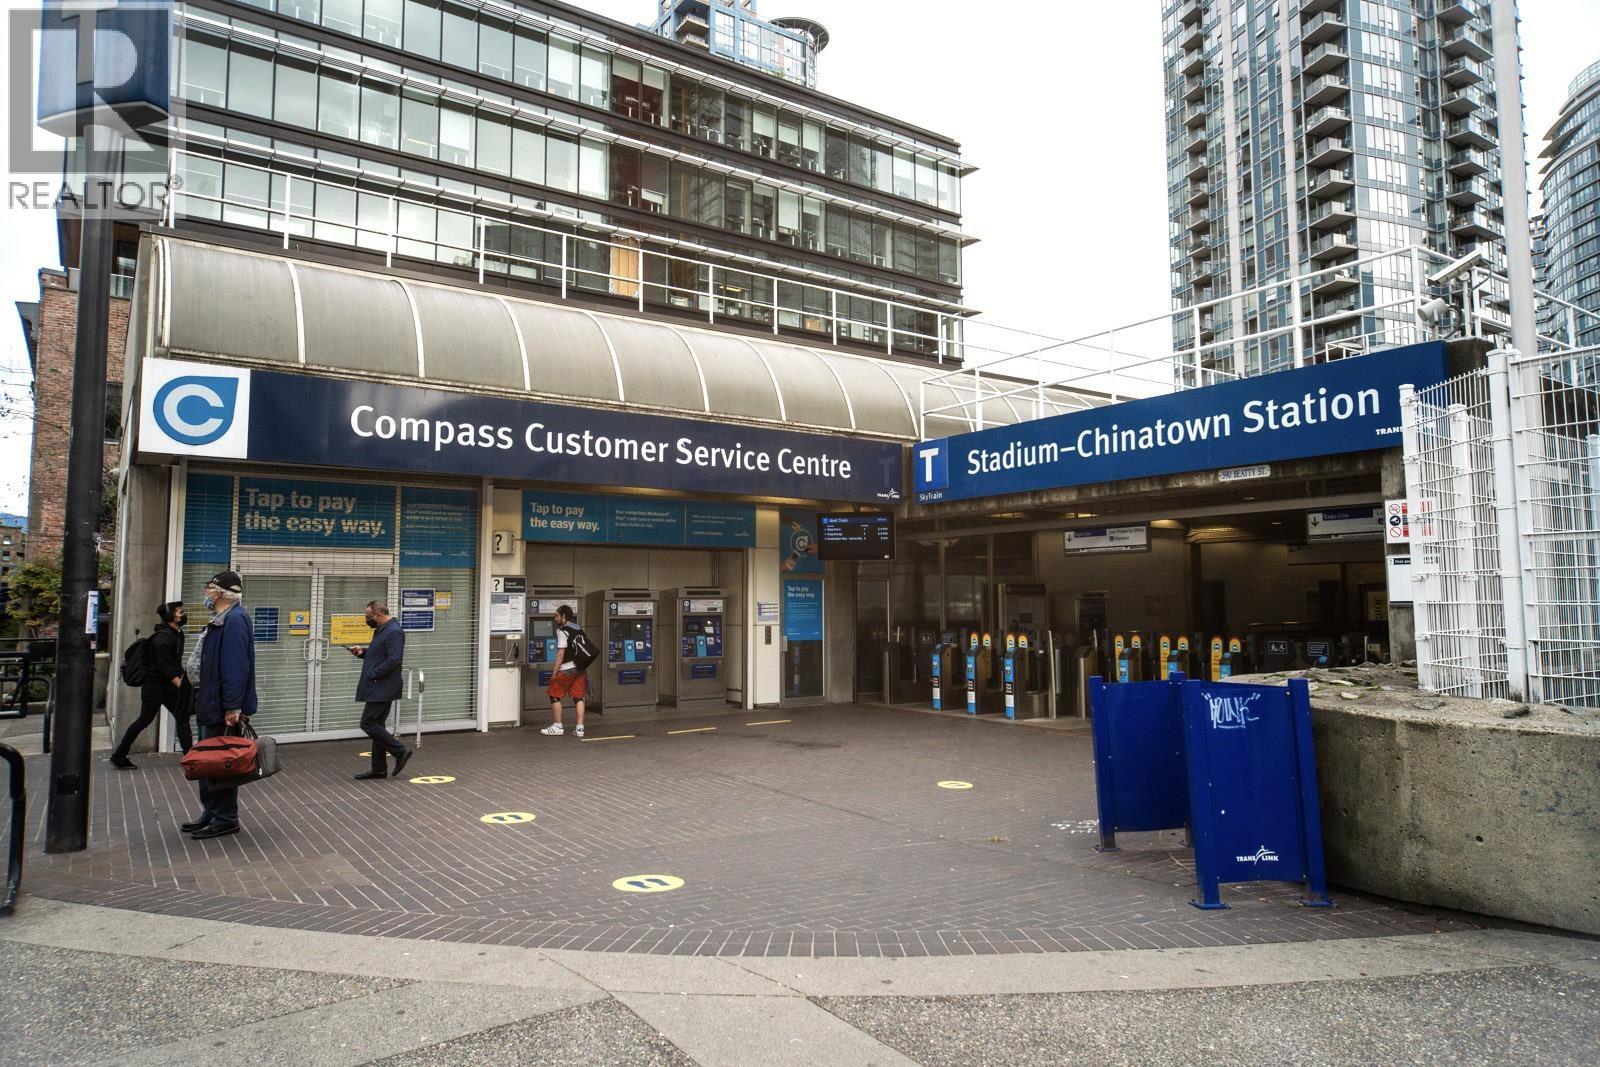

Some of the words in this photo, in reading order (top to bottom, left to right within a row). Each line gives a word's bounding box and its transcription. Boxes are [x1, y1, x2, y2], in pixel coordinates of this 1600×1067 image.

[1243, 387, 1380, 433] Station
[350, 405, 513, 452] Compass
[524, 422, 669, 463] Customer
[676, 437, 770, 472] Service
[777, 448, 851, 479] Centre
[919, 447, 939, 482] T
[1233, 467, 1256, 479] BEATTY
[244, 487, 285, 511] Tap
[290, 490, 313, 509] to
[318, 495, 358, 514] pay
[919, 490, 943, 502] SkyTrain
[530, 502, 550, 516] Tap
[551, 503, 563, 514] to
[565, 506, 585, 518] pay
[244, 511, 281, 531] the
[286, 516, 337, 537] easy
[340, 519, 386, 538] way.
[530, 517, 548, 528] the
[550, 519, 575, 531] easy
[576, 521, 600, 533] way.
